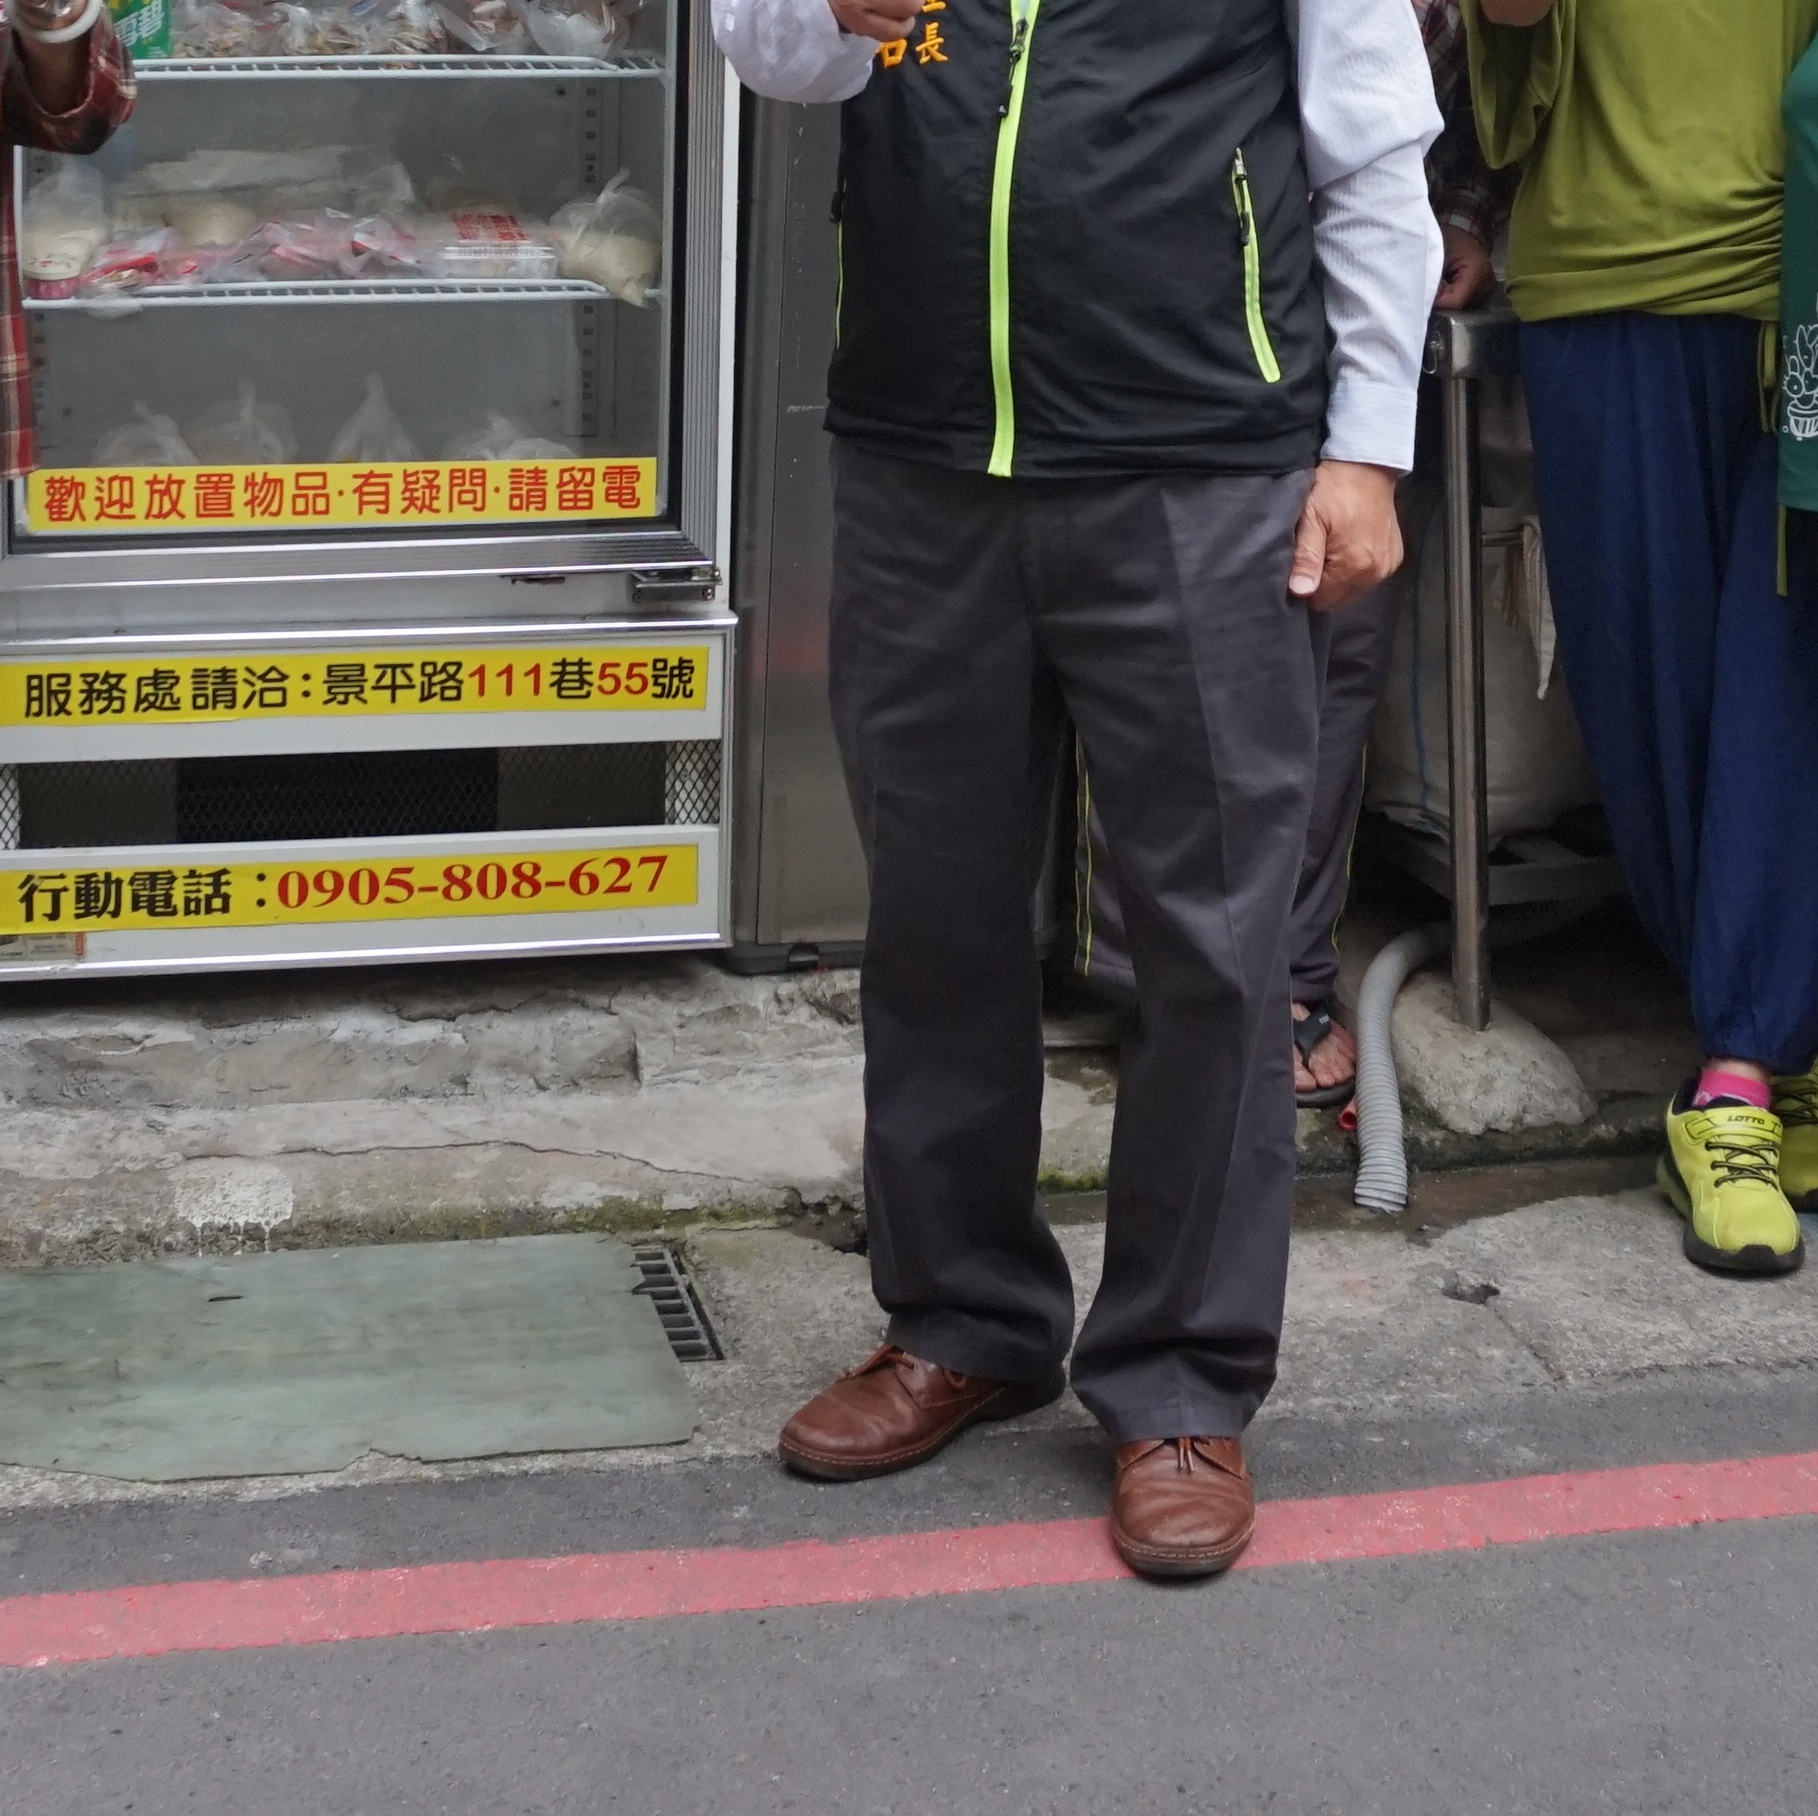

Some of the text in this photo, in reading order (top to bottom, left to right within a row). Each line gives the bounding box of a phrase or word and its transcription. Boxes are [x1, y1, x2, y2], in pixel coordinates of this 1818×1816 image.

[43, 465, 642, 524] 歡迎放置物品·有疑問·請留電
[24, 656, 696, 719] 服務處請洽:景平路111巷55號
[1727, 1115, 1765, 1124] LOTTO
